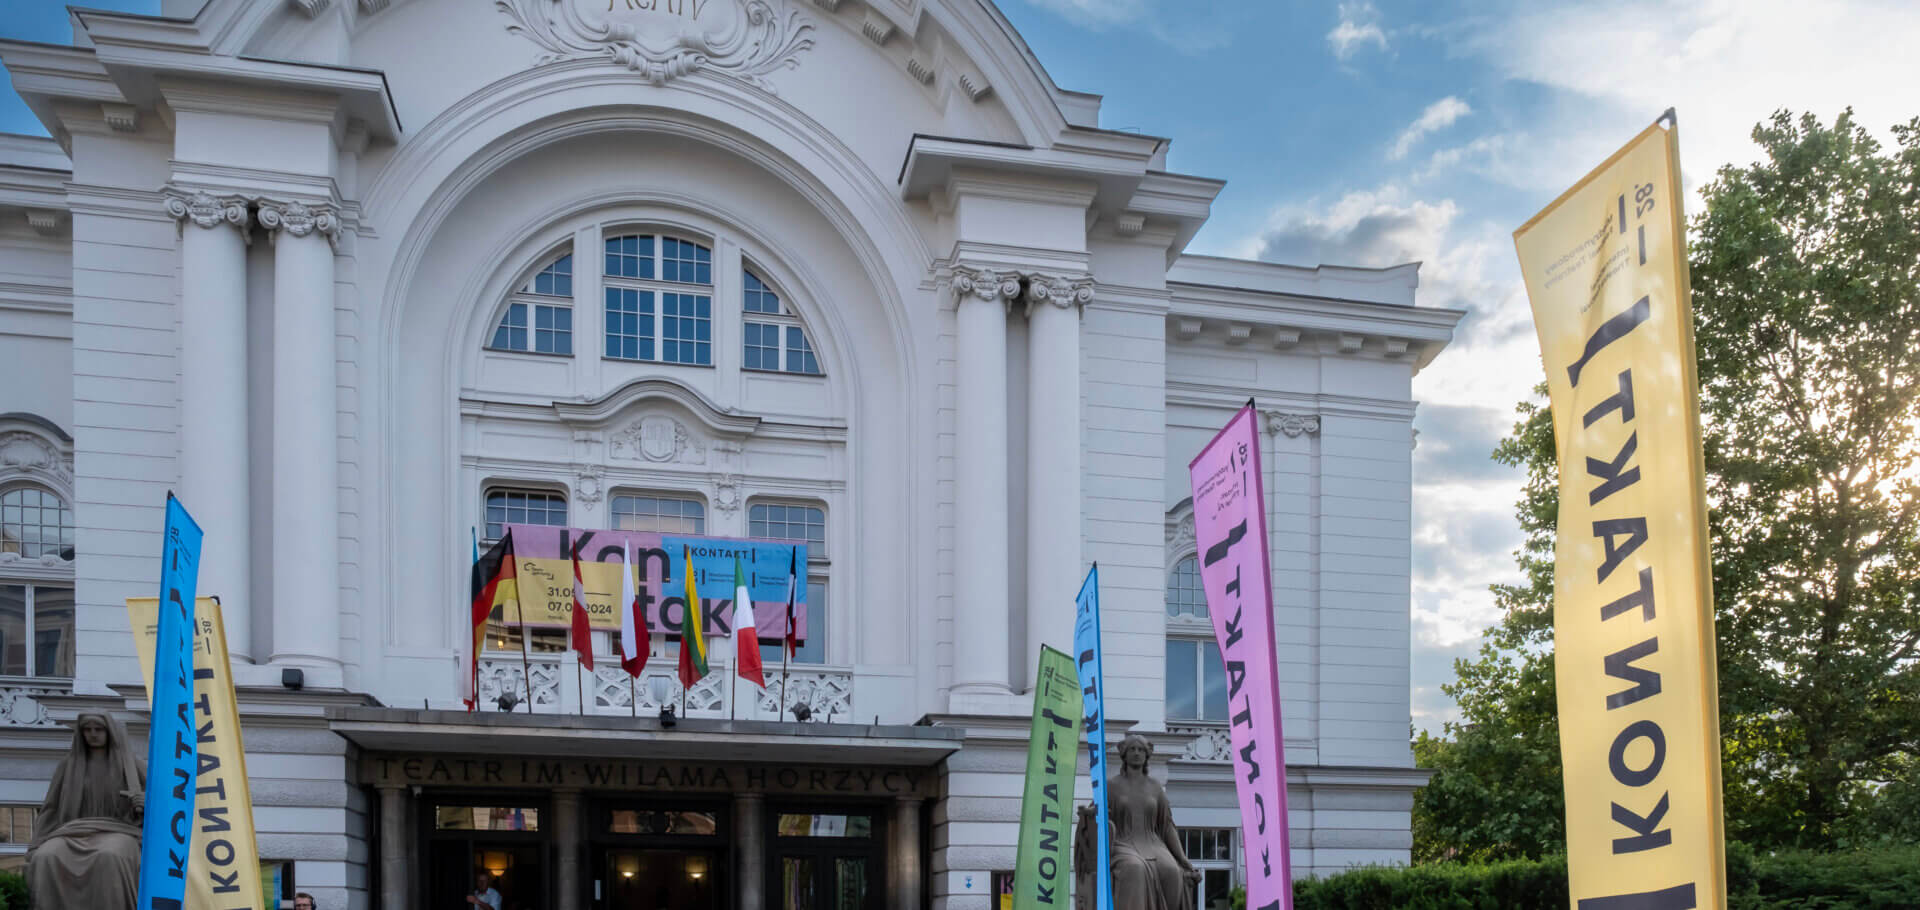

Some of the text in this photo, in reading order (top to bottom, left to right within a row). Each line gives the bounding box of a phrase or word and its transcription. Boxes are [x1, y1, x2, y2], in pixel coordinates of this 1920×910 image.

[559, 529, 671, 583] Kon
[547, 601, 612, 613] 07.02024
[376, 758, 503, 781] TEATR
[584, 762, 733, 787] WILAMA
[745, 766, 921, 792] HORZYCY
[1037, 731, 1060, 904] KONTAKT
